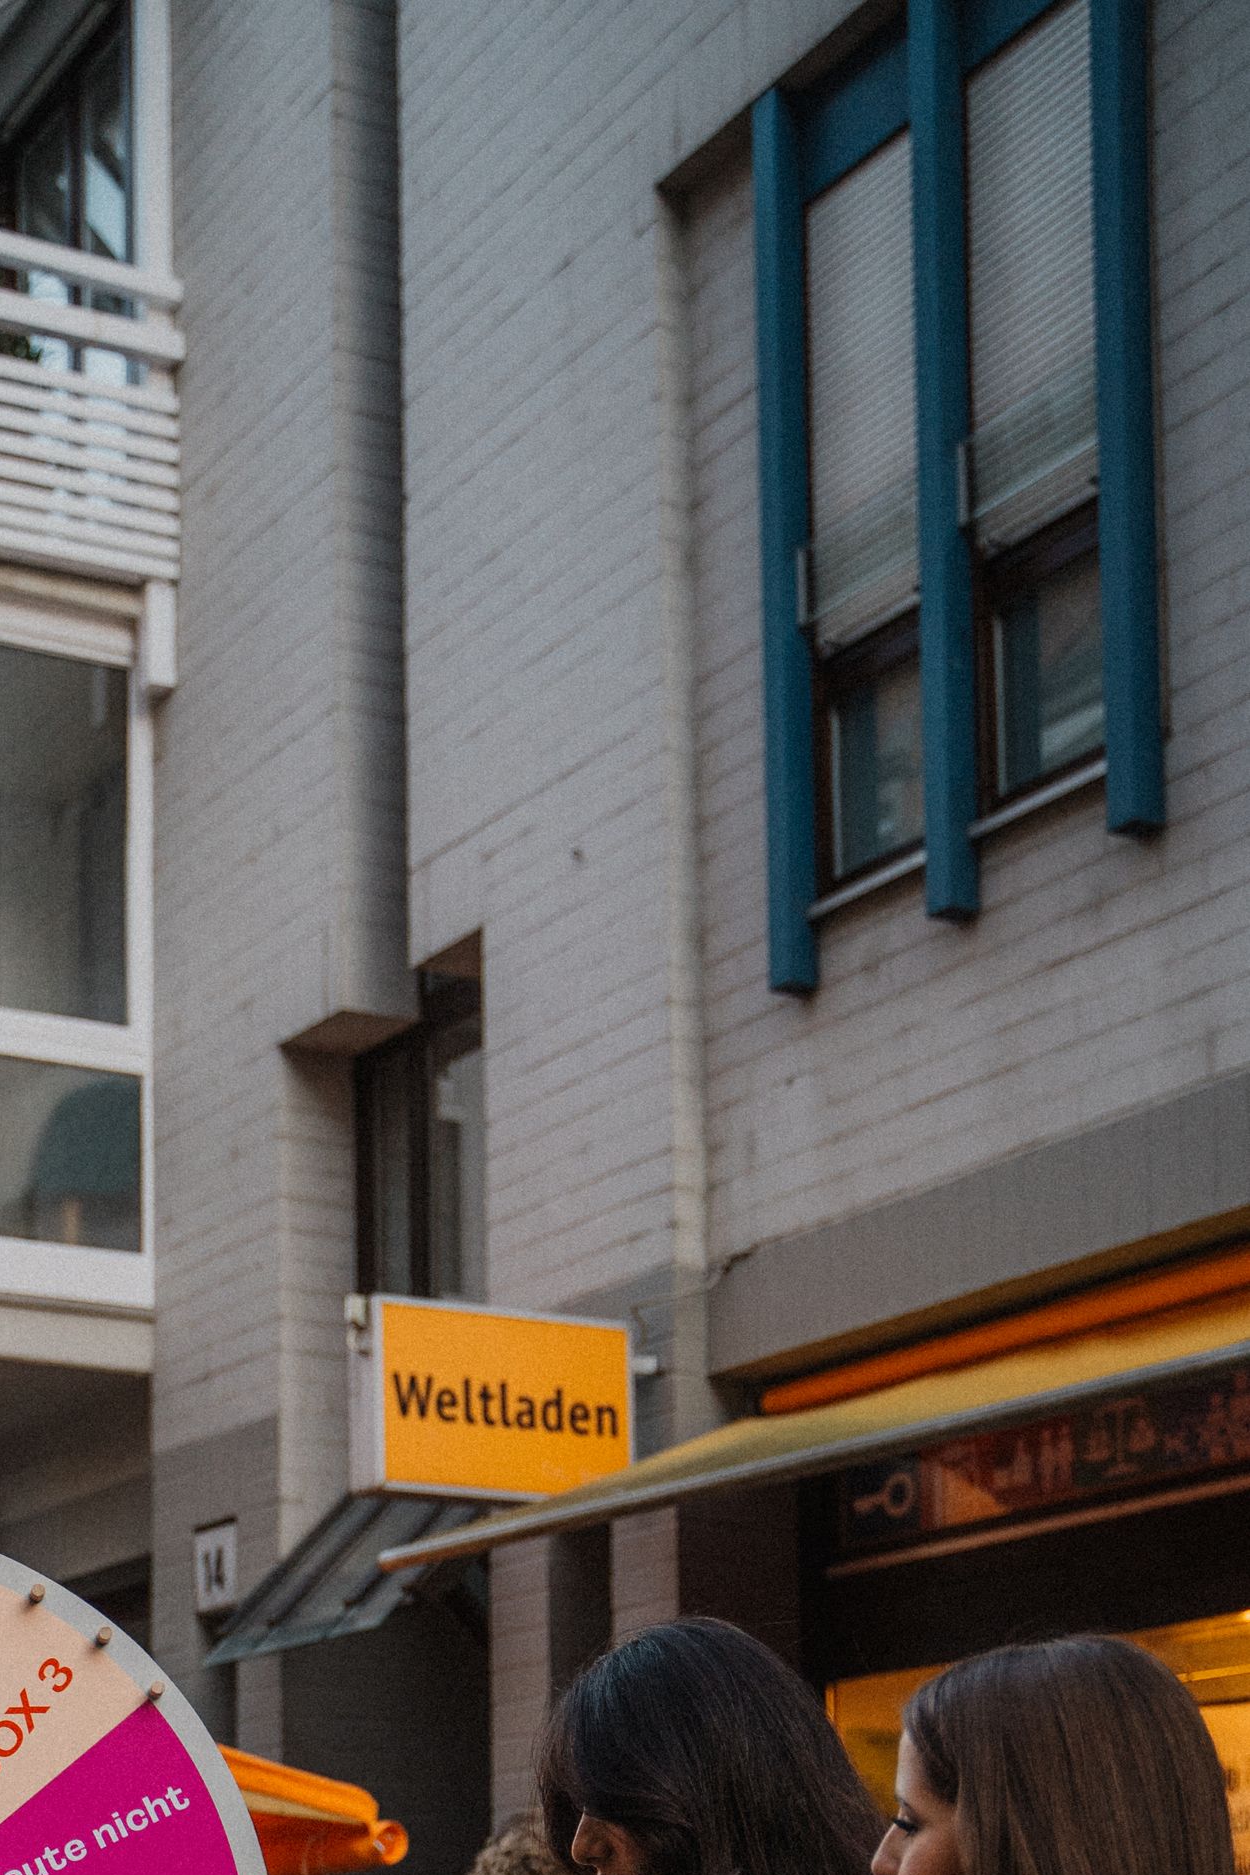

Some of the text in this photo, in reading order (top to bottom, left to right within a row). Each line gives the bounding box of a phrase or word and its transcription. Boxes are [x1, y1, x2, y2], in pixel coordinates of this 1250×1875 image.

[393, 1371, 618, 1439] Weltladen
[203, 1546, 226, 1596] 14
[38, 1658, 73, 1692] 3
[92, 1786, 190, 1849] nicht
